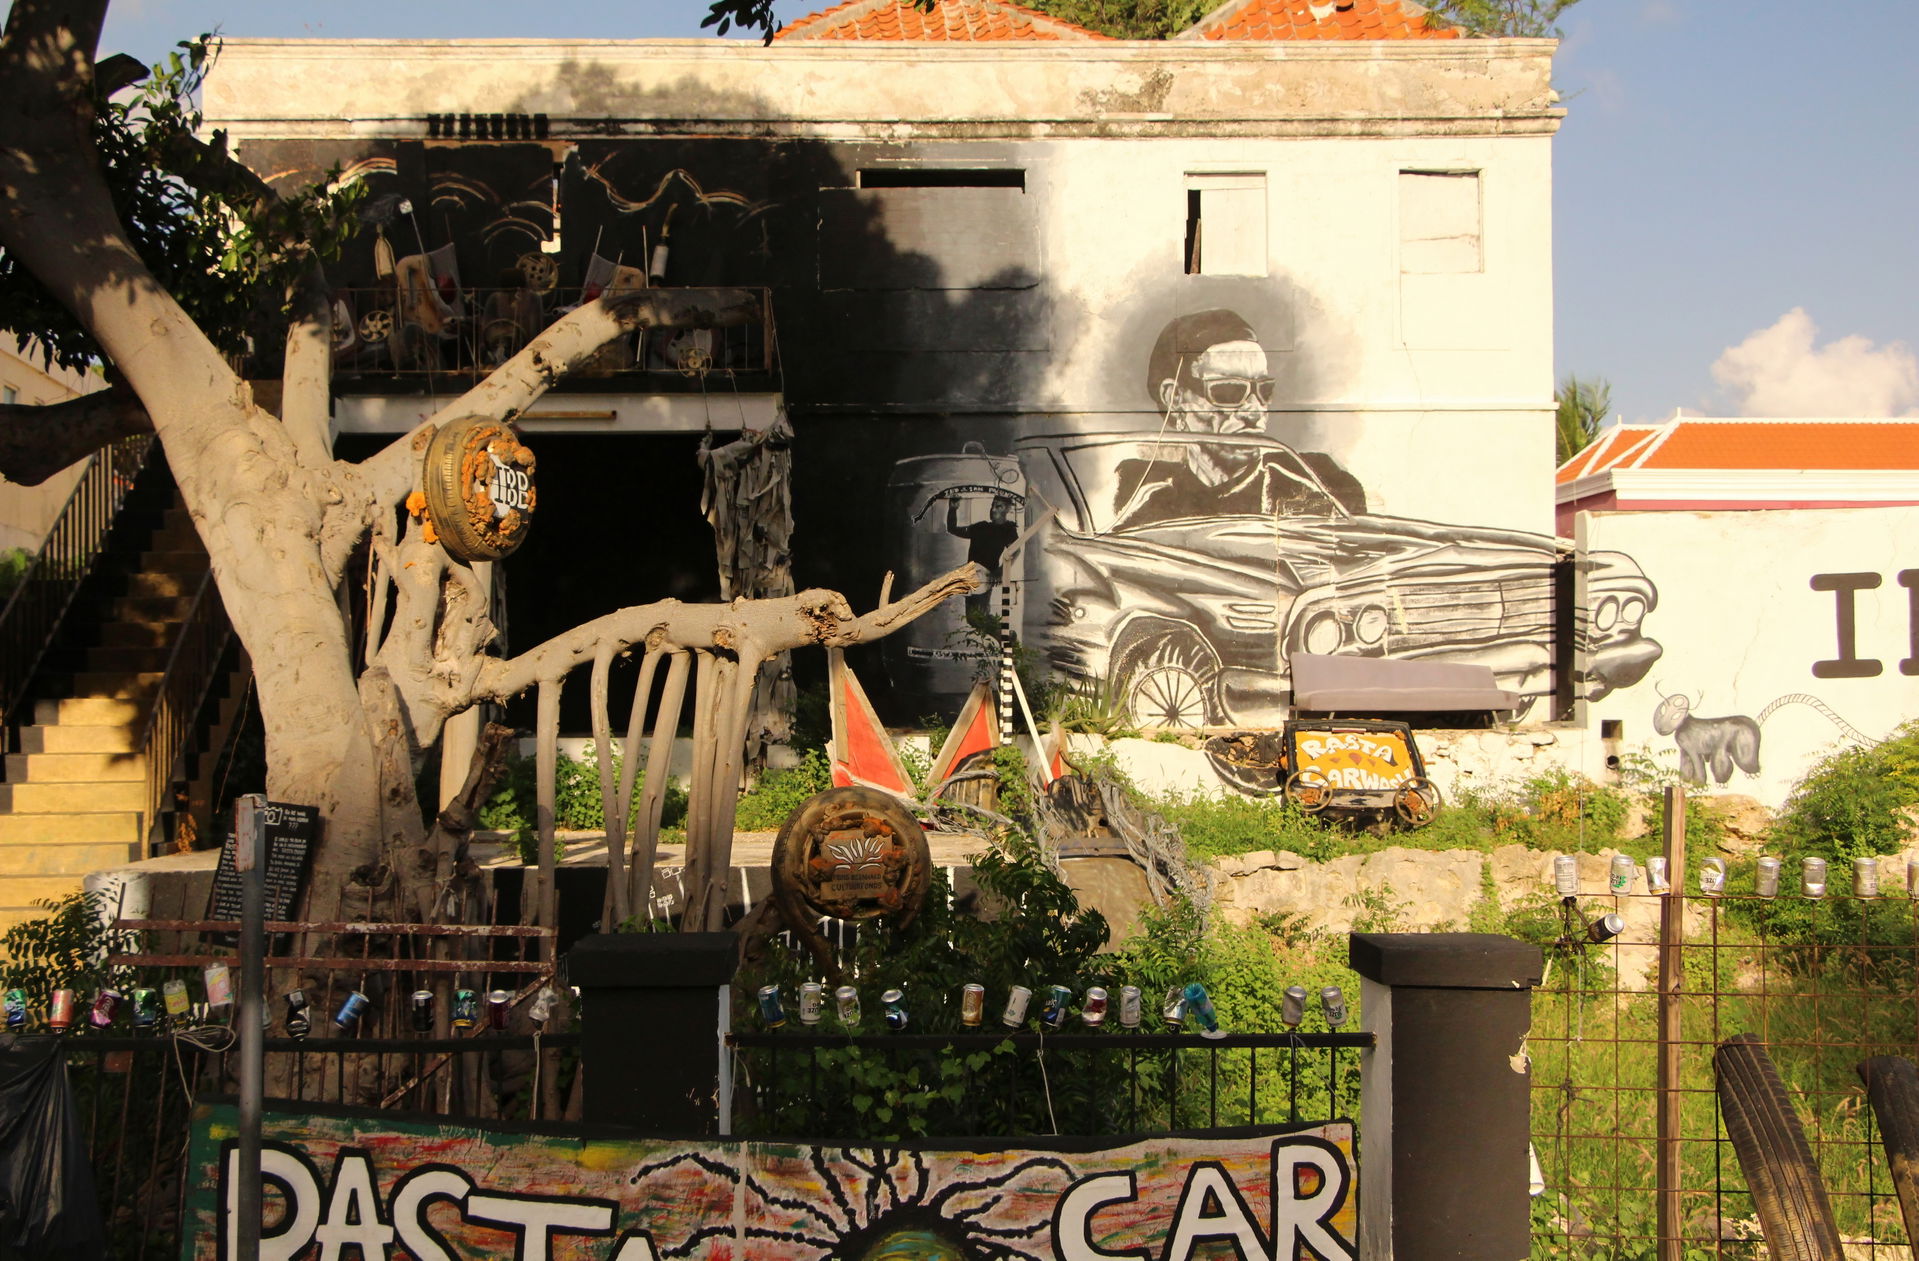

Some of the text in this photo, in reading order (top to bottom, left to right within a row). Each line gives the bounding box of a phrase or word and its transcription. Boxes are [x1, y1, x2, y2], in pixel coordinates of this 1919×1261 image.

[1809, 568, 1919, 679] I
[1301, 735, 1396, 762] RASTA
[217, 1134, 1358, 1261] RAST CAR
